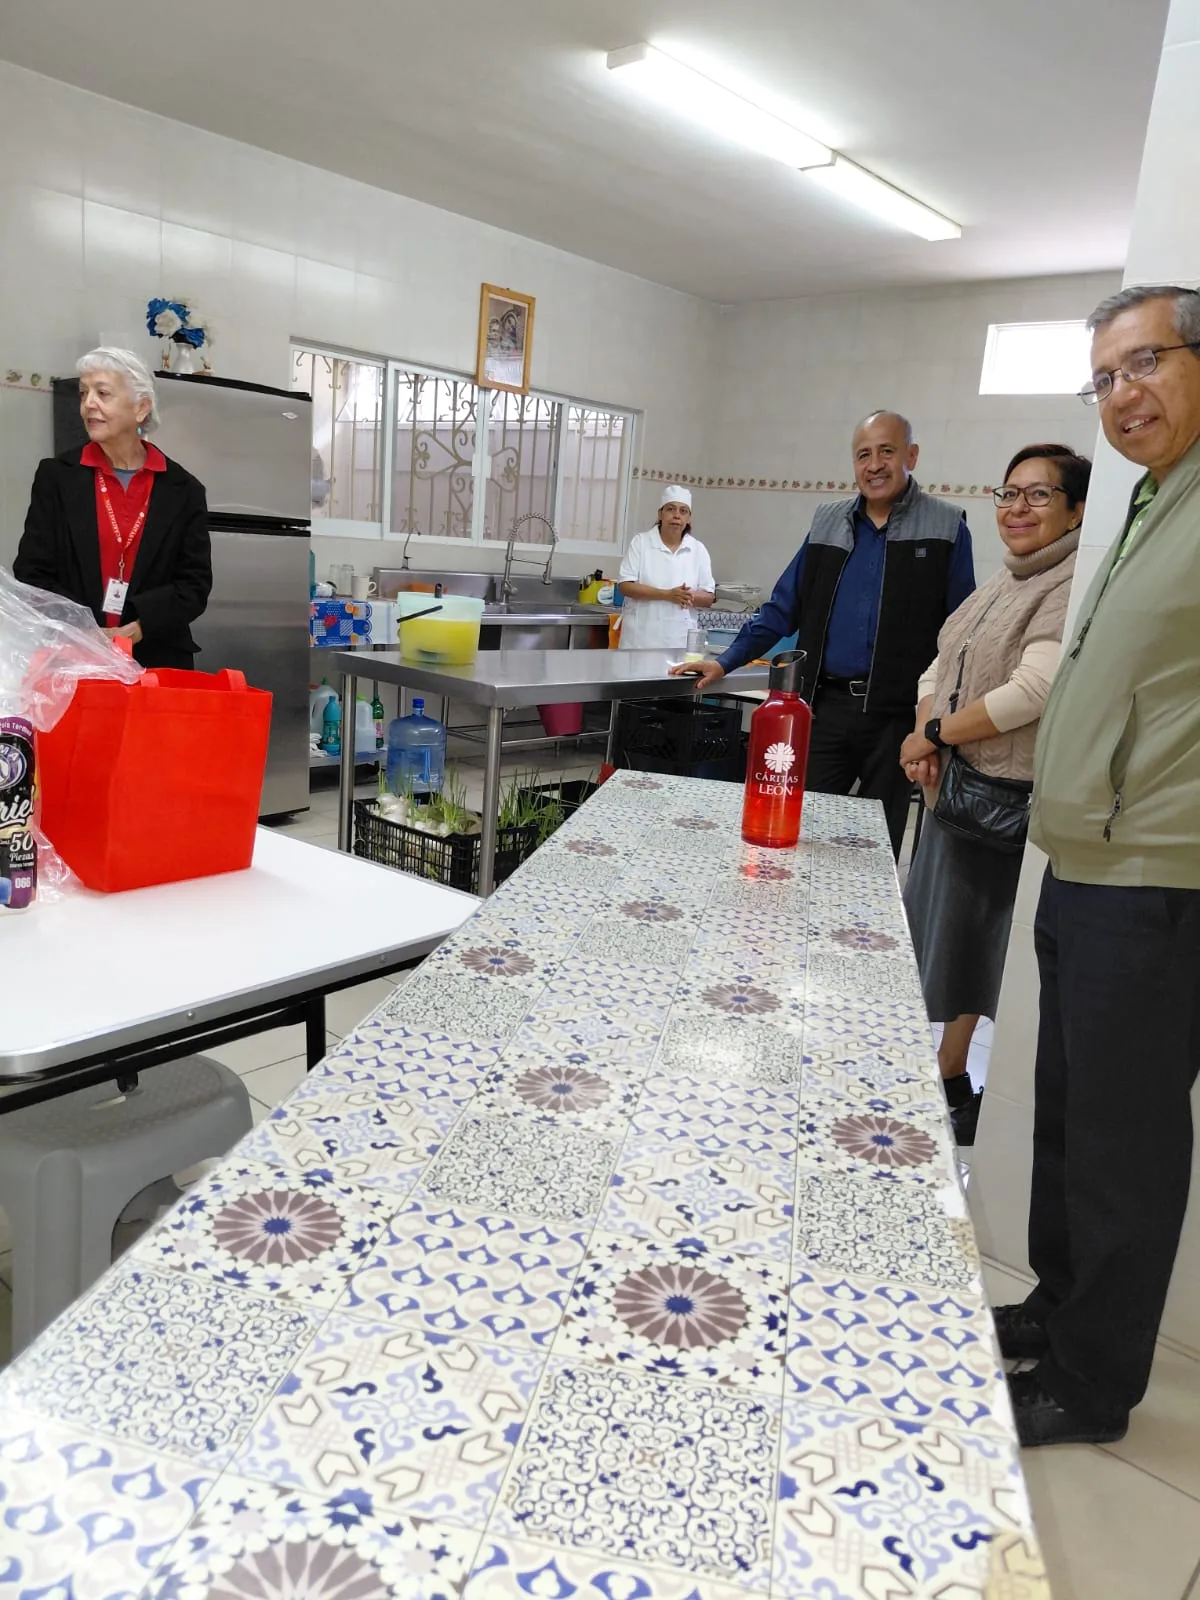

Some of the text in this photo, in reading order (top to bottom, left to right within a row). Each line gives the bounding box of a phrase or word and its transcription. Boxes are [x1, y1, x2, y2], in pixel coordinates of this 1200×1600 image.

[755, 771, 799, 783] CÁRITAS
[758, 783, 794, 796] LEÓN
[9, 833, 34, 852] 50
